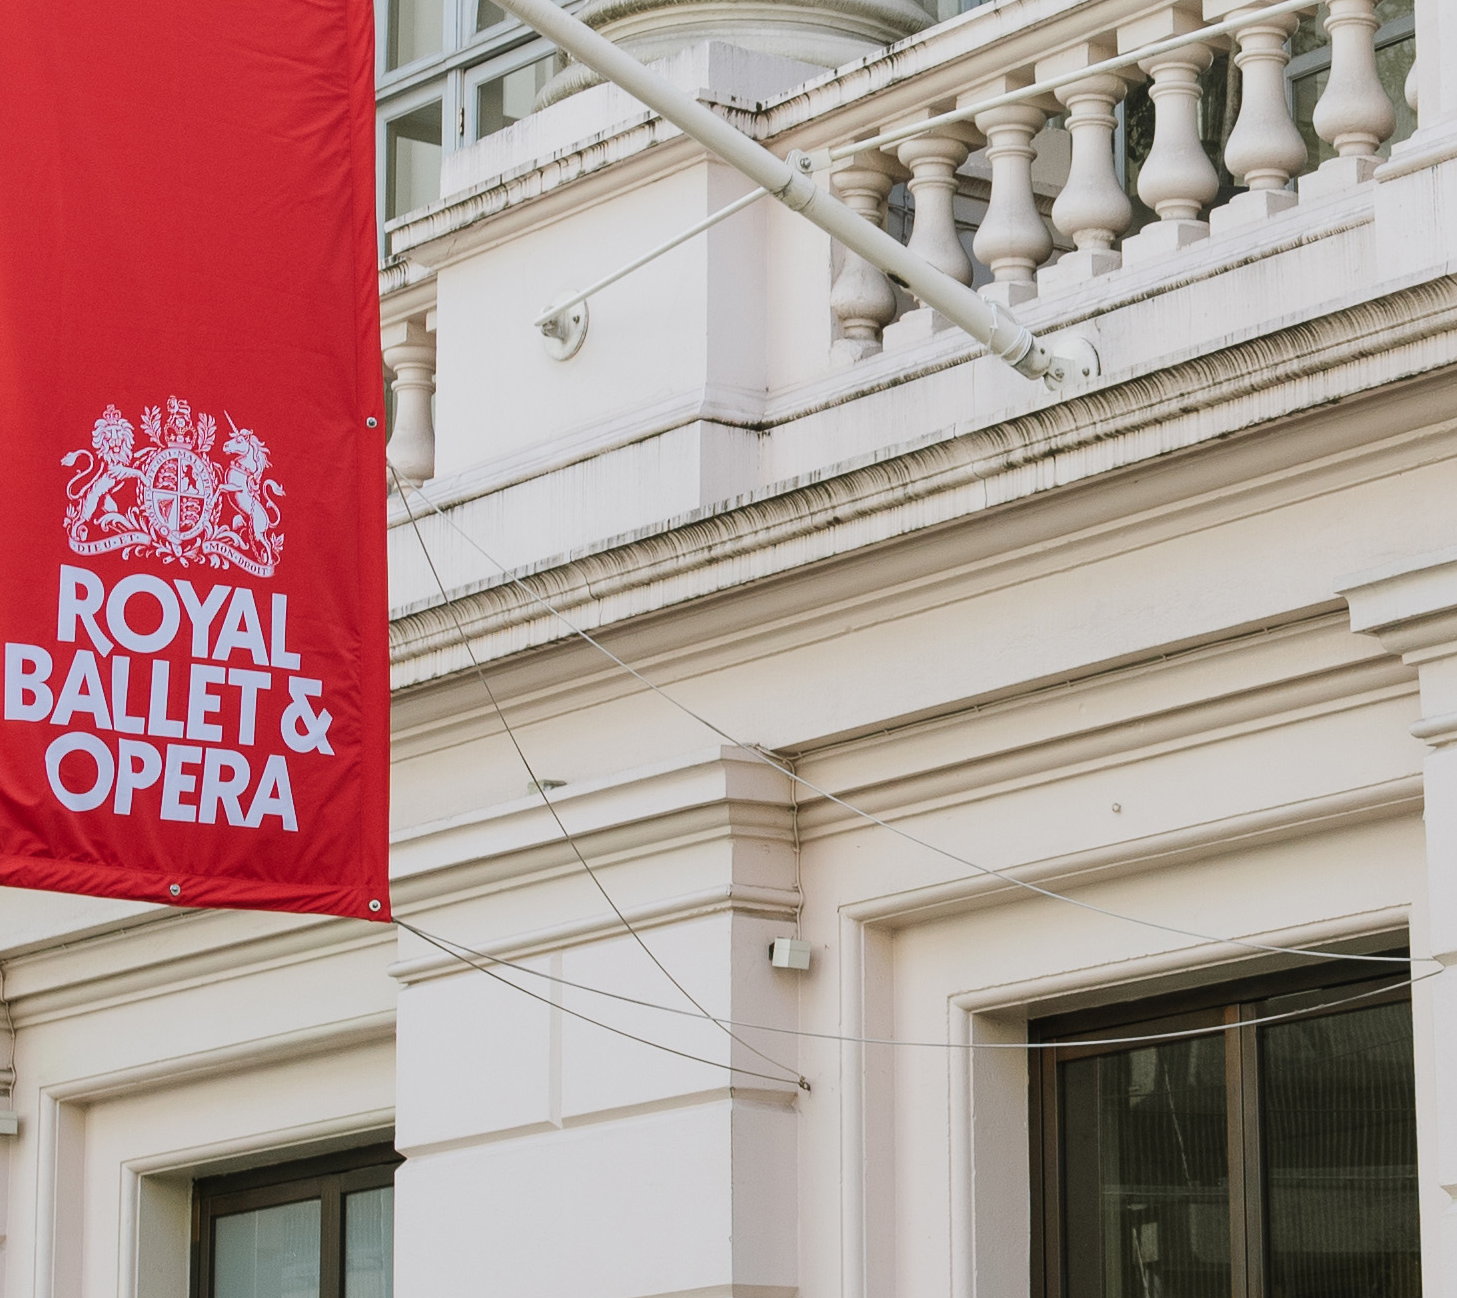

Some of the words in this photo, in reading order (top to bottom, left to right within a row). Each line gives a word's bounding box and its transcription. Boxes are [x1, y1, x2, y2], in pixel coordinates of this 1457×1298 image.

[77, 541, 113, 552] DIEU
[209, 542, 235, 558] MON
[238, 556, 268, 575] DROIT
[57, 564, 301, 670] ROYAL
[4, 642, 272, 746] BALLET
[281, 675, 336, 756] &
[45, 731, 299, 832] OPERA
